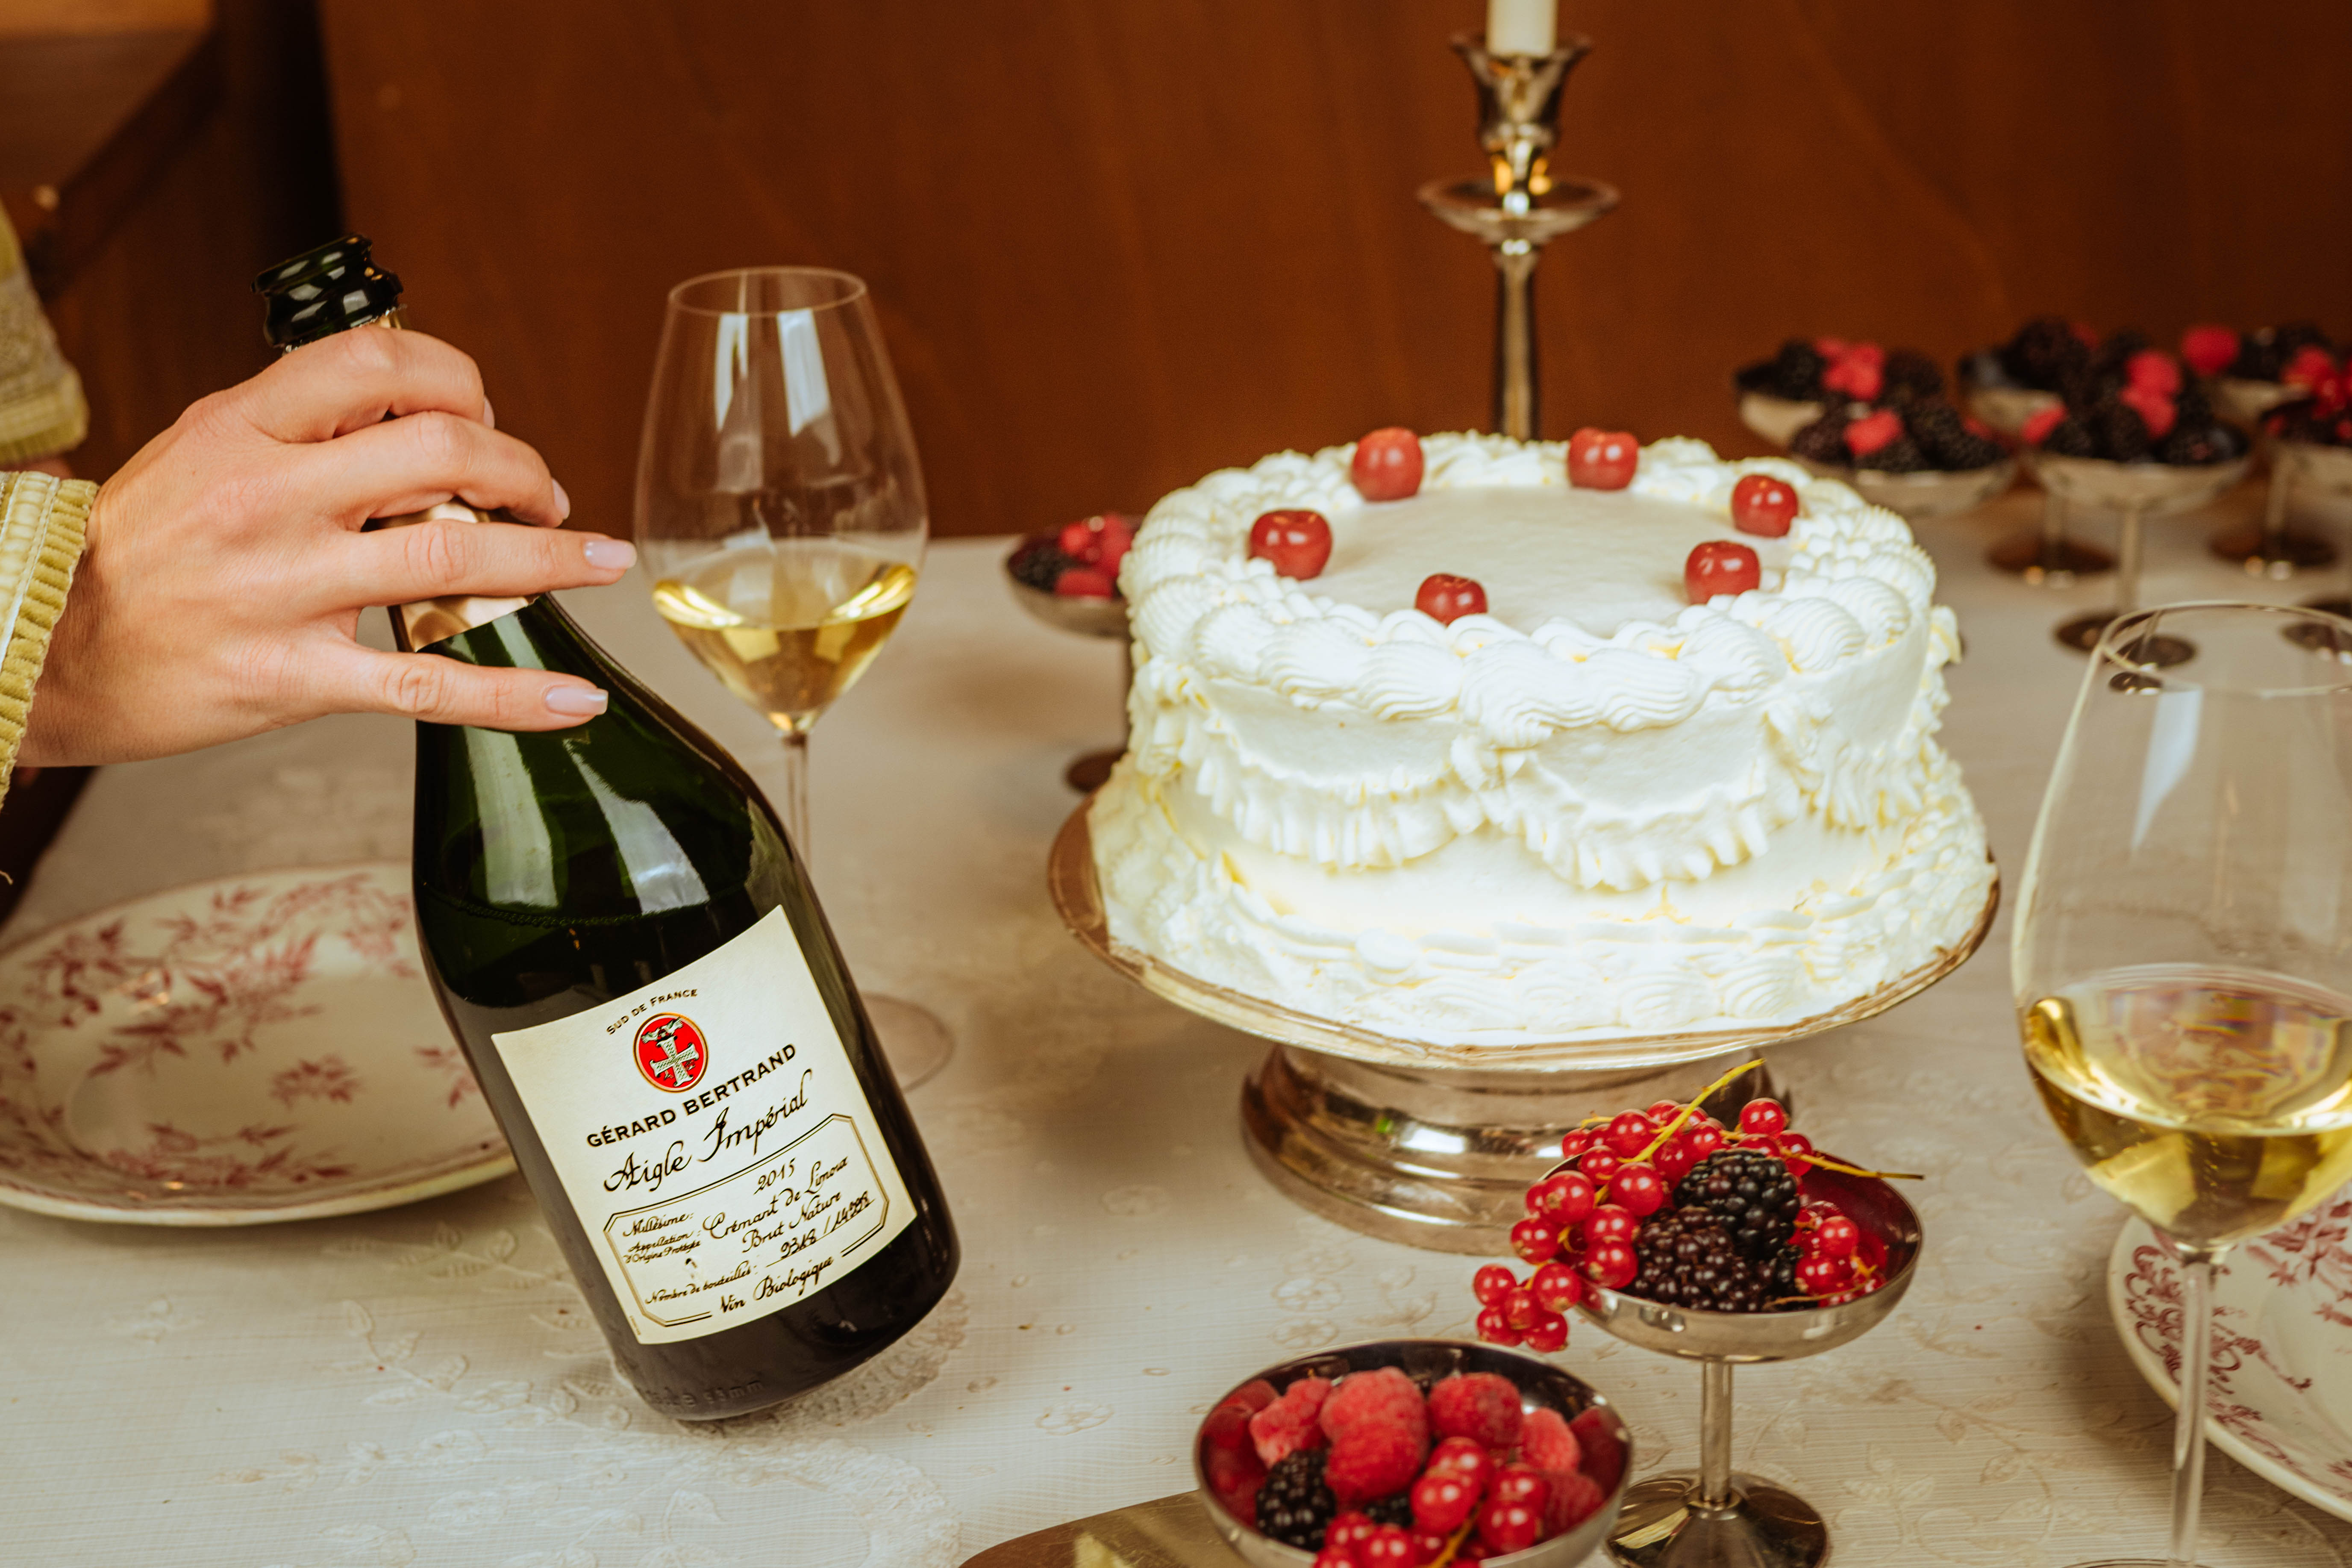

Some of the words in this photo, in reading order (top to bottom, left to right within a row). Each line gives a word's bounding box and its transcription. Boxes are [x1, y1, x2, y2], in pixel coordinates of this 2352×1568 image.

[606, 1015, 629, 1035] SUD
[631, 1003, 647, 1017] DE
[650, 988, 697, 1006] FRANCE
[587, 1109, 676, 1148] GÉRARD
[682, 1044, 796, 1116] BERTRAND
[603, 1140, 692, 1192] Aigle
[697, 1068, 812, 1162] Impérial
[703, 1194, 778, 1239] Crémant
[778, 1188, 801, 1207] de
[804, 1156, 848, 1194] Limoux
[753, 1157, 796, 1195] 2015
[742, 1221, 785, 1253] Brut
[789, 1192, 841, 1229] Nature
[645, 1289, 688, 1304] Nombre
[686, 1283, 700, 1294] de
[720, 1294, 746, 1313] Vin
[753, 1256, 833, 1300] Biologique
